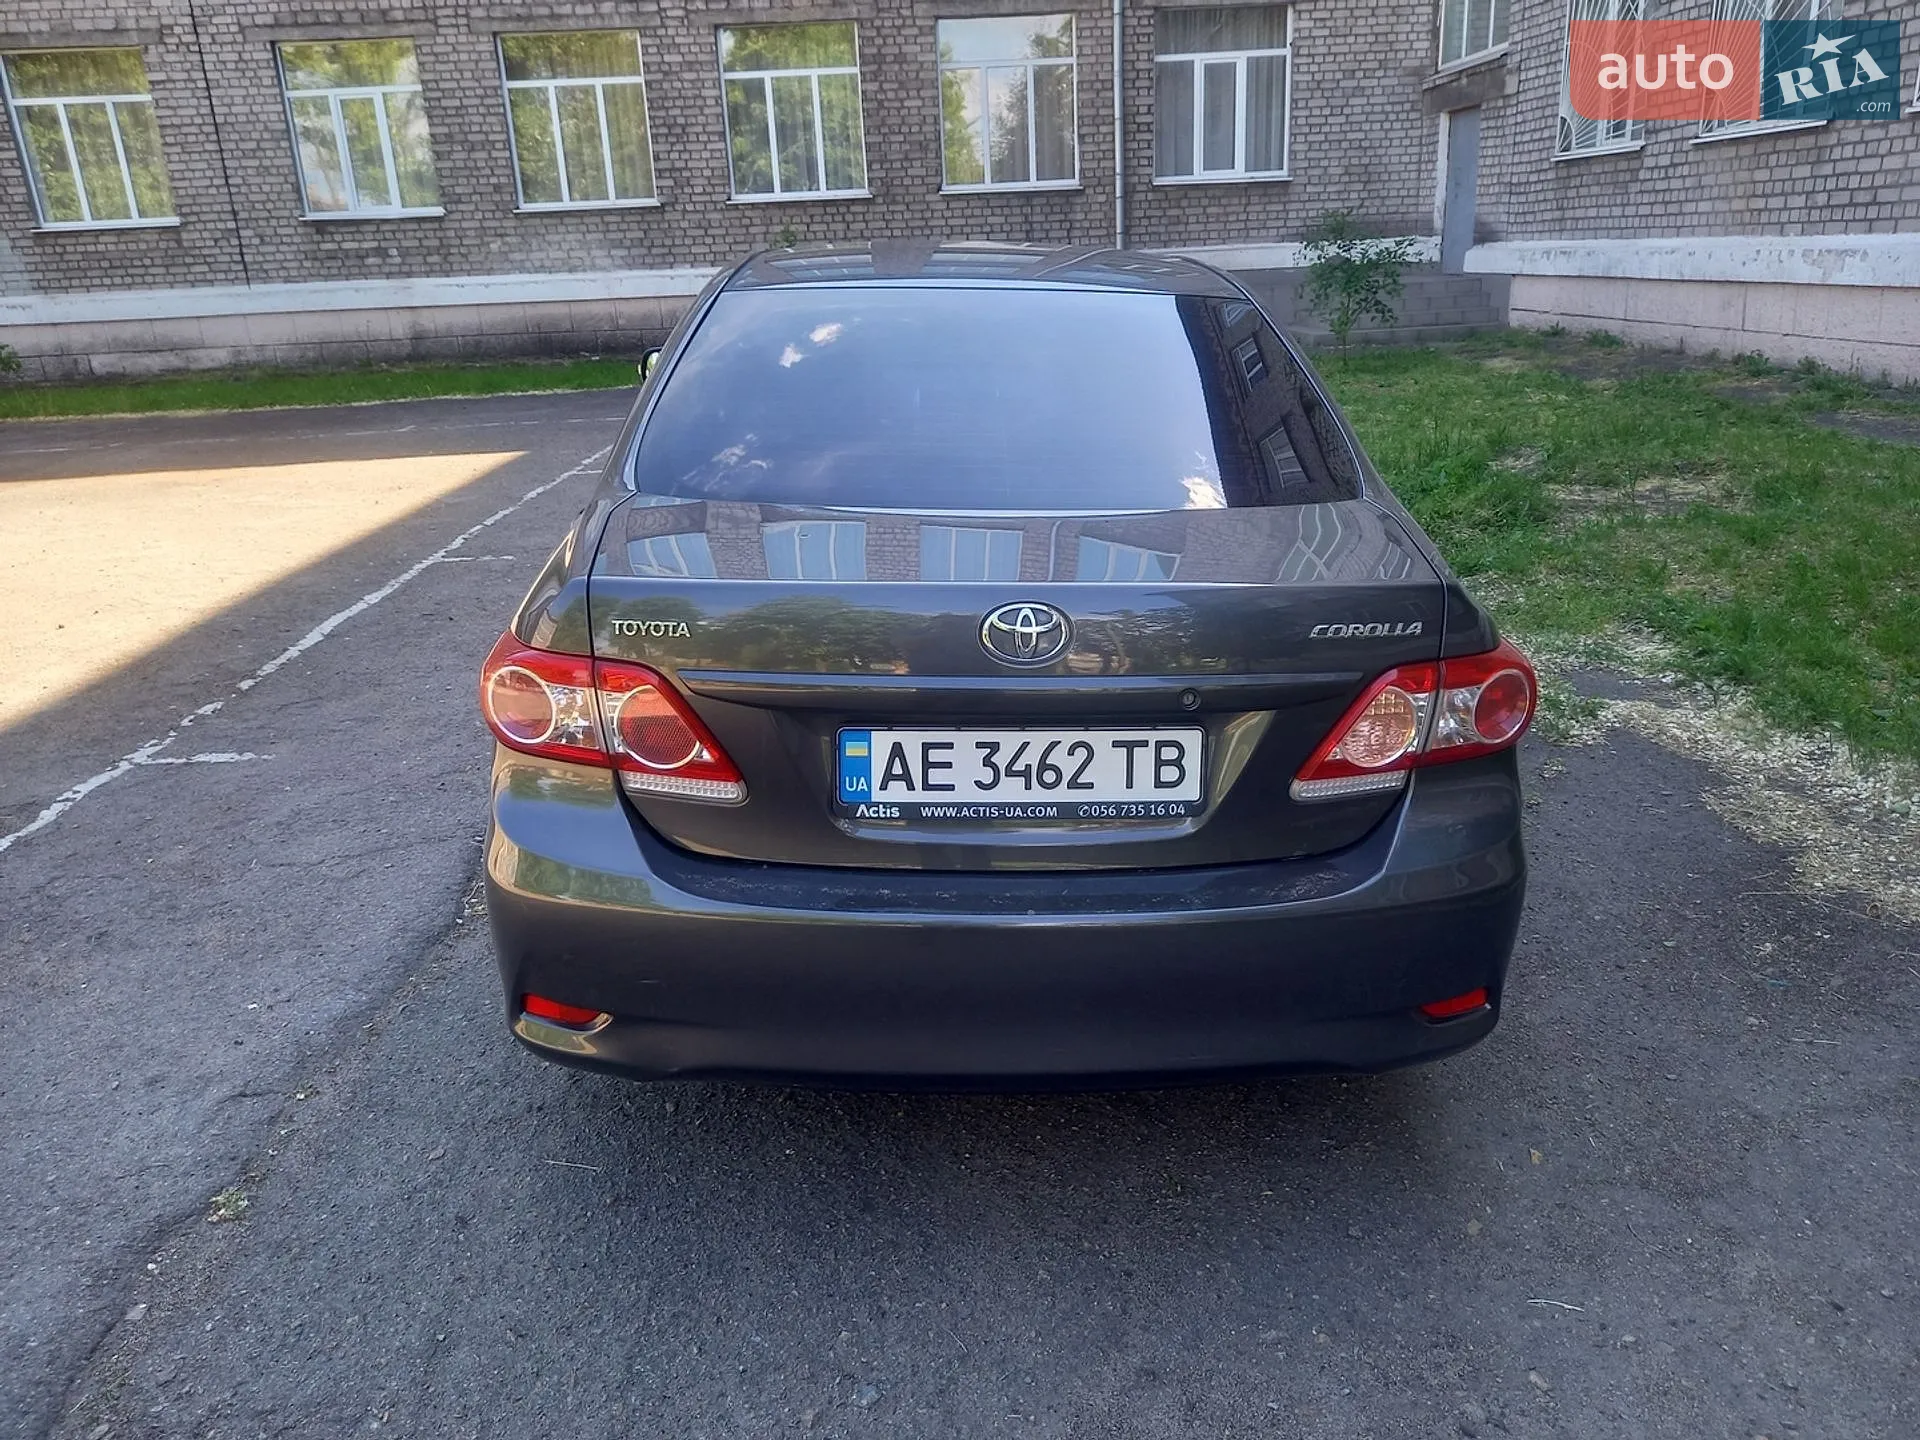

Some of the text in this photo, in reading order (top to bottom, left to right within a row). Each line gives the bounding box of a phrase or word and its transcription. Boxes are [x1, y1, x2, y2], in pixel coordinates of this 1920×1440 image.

[611, 620, 691, 637] TOYOTA
[1308, 621, 1423, 638] COROLLA
[878, 740, 1187, 791] AE 3462 TB
[845, 776, 868, 792] UA
[855, 804, 900, 818] Actis
[920, 806, 1058, 818] WWW.ACTIS-UA.COM
[1120, 804, 1145, 817] 735
[1150, 804, 1166, 816] 16
[1168, 803, 1185, 816] 04
